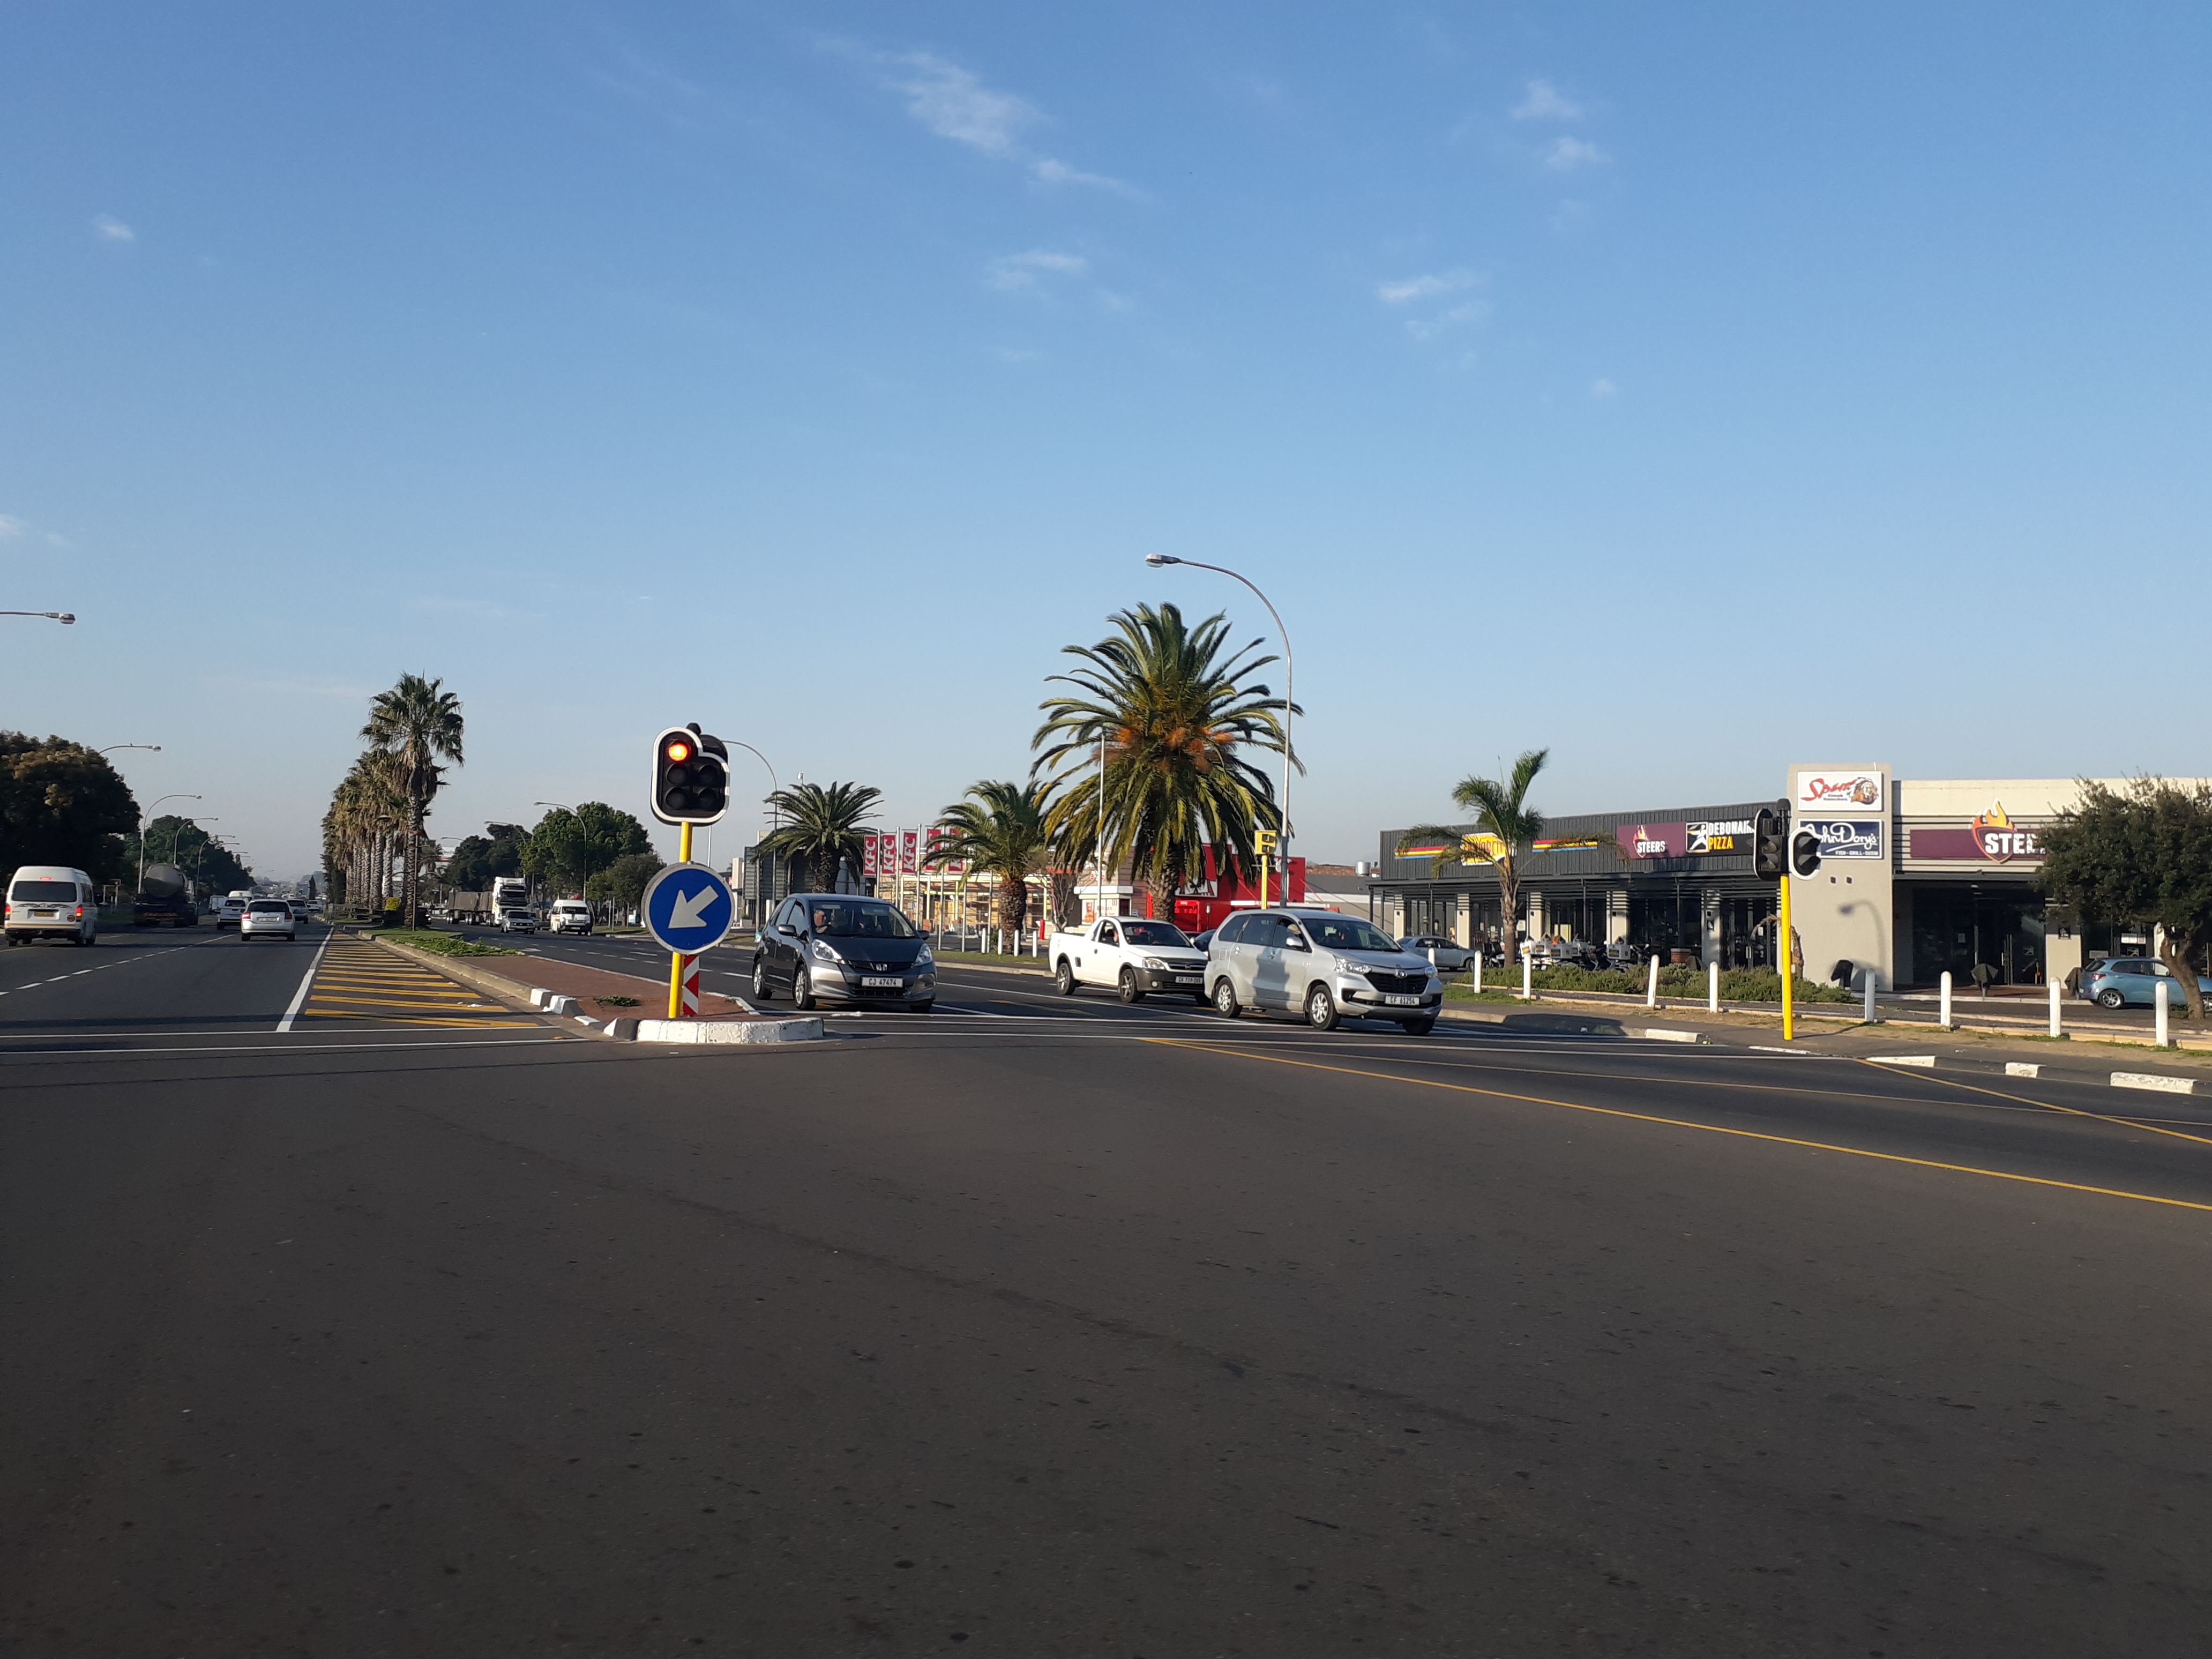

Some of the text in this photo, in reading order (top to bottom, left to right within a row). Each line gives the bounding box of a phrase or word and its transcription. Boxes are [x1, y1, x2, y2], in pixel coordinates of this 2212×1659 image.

[1708, 820, 1754, 836] DEBONAIR
[1636, 840, 1666, 854] STEERS
[1708, 836, 1734, 849] PIZZA
[1985, 833, 2046, 854] STEE
[865, 840, 876, 872] KFC
[884, 839, 894, 872] KFC
[903, 836, 916, 871] KFC
